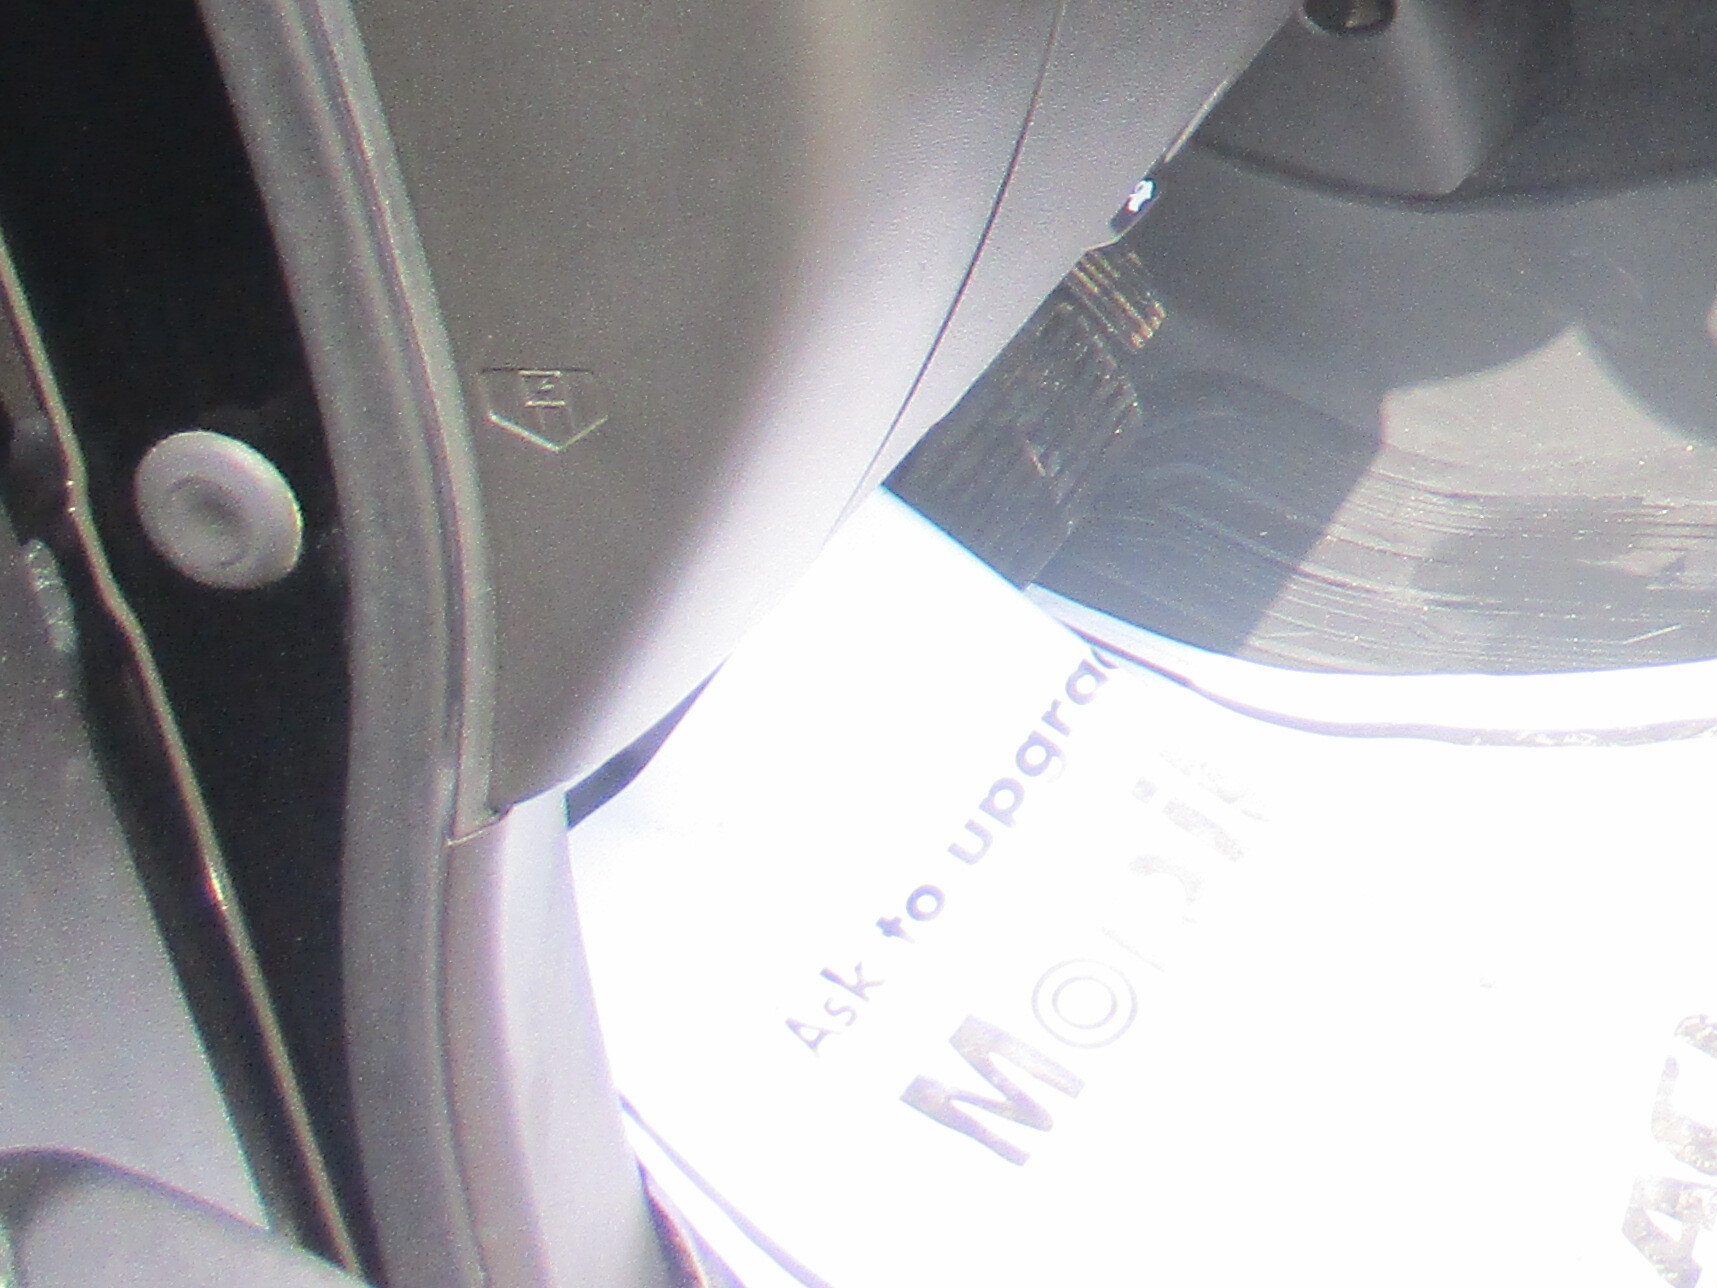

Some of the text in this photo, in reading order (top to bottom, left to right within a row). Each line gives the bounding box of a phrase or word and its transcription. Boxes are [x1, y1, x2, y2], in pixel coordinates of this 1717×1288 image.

[784, 645, 1119, 1057] Ask to upgra
